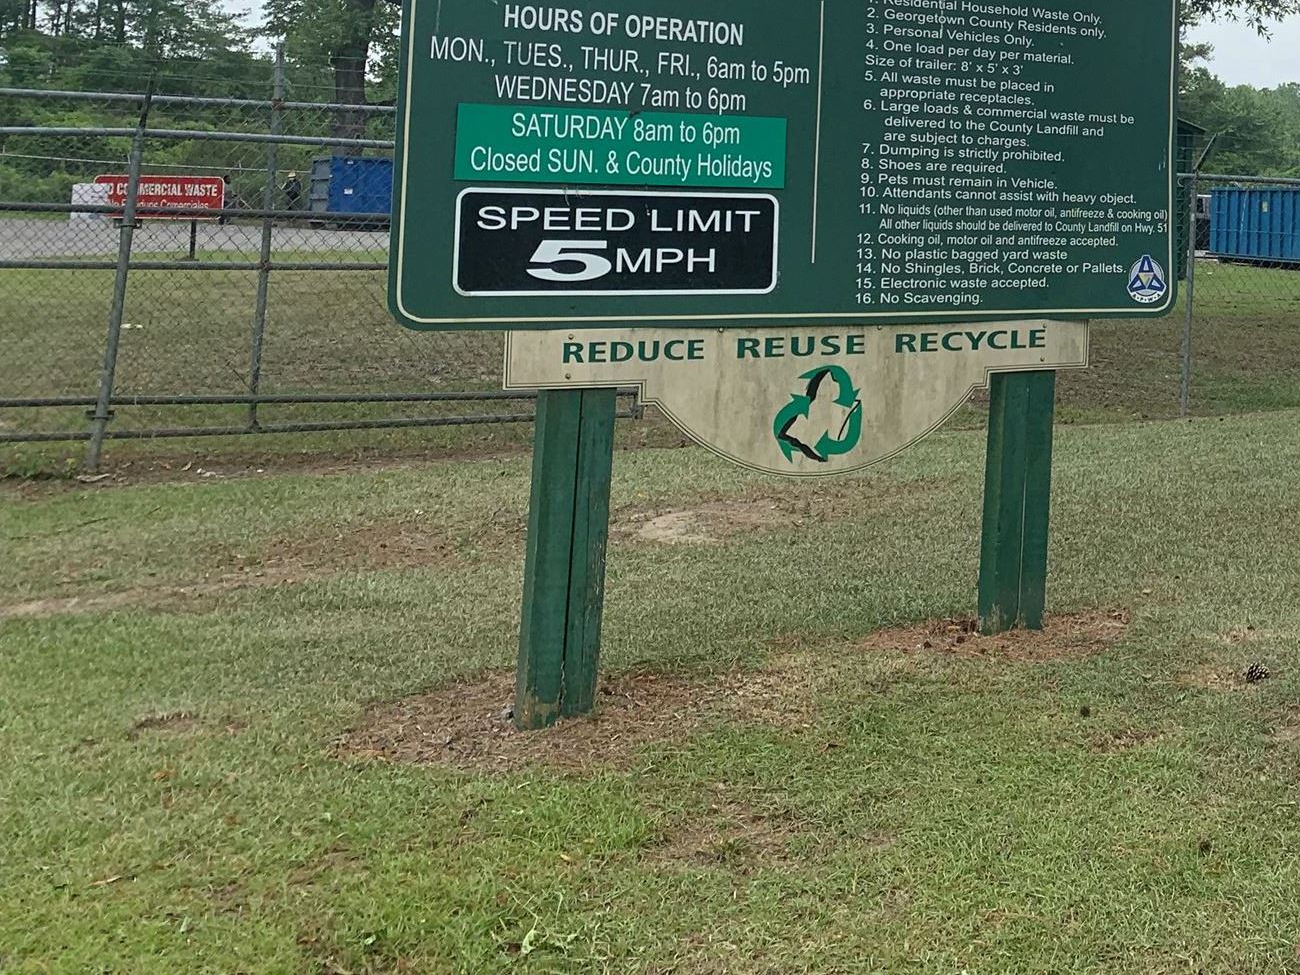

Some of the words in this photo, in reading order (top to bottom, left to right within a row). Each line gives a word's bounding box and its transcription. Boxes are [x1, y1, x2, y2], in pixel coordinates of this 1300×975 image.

[504, 4, 583, 33] HOURS
[590, 11, 619, 35] OF
[625, 14, 743, 46] OPERATION
[867, 7, 879, 18] 2.
[884, 8, 965, 25] Georgetown
[969, 16, 1014, 32] County
[1018, 20, 1077, 35] Residents
[1080, 27, 1107, 40] only.
[961, 1, 1028, 17] Household
[1032, 7, 1069, 21] Waste
[1073, 11, 1102, 26] Only.
[866, 23, 879, 34] 3.
[883, 24, 943, 40] Personal
[946, 29, 1000, 44] Vehicles
[1004, 34, 1034, 48] Only.
[430, 35, 495, 67] MON.,
[503, 40, 573, 72] TUES.,
[580, 46, 649, 77] THUR.,
[658, 52, 700, 81] FRI.,
[707, 56, 745, 80] 6am
[751, 60, 767, 81] to
[773, 61, 809, 88] 5pm
[865, 39, 879, 50] 4.
[883, 40, 912, 52] One
[916, 42, 944, 54] load
[948, 47, 970, 57] per
[973, 47, 996, 61] day
[1000, 51, 1020, 61] per
[1023, 52, 1074, 65] material.
[864, 70, 877, 81] 5.
[880, 71, 898, 82] All
[902, 75, 941, 85] waste
[945, 77, 977, 87] must
[981, 78, 996, 89] be
[1000, 79, 1040, 92] placed
[1044, 82, 1054, 93] in
[495, 74, 635, 105] WEDNESDAY
[640, 83, 679, 108] 7am
[685, 87, 702, 109] to
[708, 87, 746, 116] 6pm
[880, 88, 956, 101] appropriate
[960, 93, 1035, 105] receptacles.
[863, 99, 876, 110] 6.
[881, 100, 920, 115] Large
[924, 102, 959, 114] loads
[963, 104, 972, 115] &
[976, 108, 1047, 119] commercial
[1050, 112, 1085, 122] waste
[1088, 114, 1117, 123] must
[1120, 113, 1135, 124] be
[512, 112, 628, 140] SATURDAY
[633, 118, 673, 142] 8am
[679, 120, 696, 143] to
[703, 122, 740, 149] 6pm
[884, 116, 946, 129] delivered
[949, 119, 962, 130] to
[966, 120, 986, 131] the
[989, 121, 1033, 135] County
[1036, 123, 1078, 135] Landfill
[1082, 126, 1104, 137] and
[471, 146, 541, 172] Closed
[548, 148, 598, 173] SUN.
[606, 150, 619, 174] &
[626, 151, 692, 182] County
[697, 153, 772, 183] Holidays
[862, 143, 874, 155] 7.
[879, 144, 939, 159] Dumping
[944, 146, 954, 157] is
[958, 148, 999, 161] strictly
[1002, 150, 1065, 162] prohibited.
[861, 158, 873, 169] 8.
[878, 158, 921, 171] Shoes
[926, 162, 947, 171] are
[951, 162, 1007, 174] required.
[117, 183, 182, 196] COMERCIAL
[185, 183, 218, 197] WASTE
[860, 172, 873, 184] 9.
[878, 173, 908, 185] Pets
[913, 176, 945, 186] must
[949, 176, 992, 187] remain
[996, 177, 1007, 187] in
[1011, 177, 1057, 189] Vehicle.
[860, 186, 879, 197] 10.
[882, 187, 952, 199] Attendants
[955, 190, 996, 200] cannot
[999, 190, 1033, 201] assist
[1036, 191, 1059, 202] with
[1063, 191, 1097, 205] heavy
[1099, 193, 1137, 206] object.
[477, 206, 635, 231] SPEED
[651, 209, 761, 232] LIMIT
[859, 203, 876, 214] 11.
[880, 203, 895, 214] No
[898, 204, 931, 217] liquids
[934, 204, 964, 217] (other
[966, 205, 987, 216] than
[989, 206, 1013, 217] used
[1015, 207, 1042, 217] motor
[1044, 207, 1057, 219] oil,
[1060, 207, 1105, 218] antifreeze
[1107, 208, 1114, 219] &
[1116, 209, 1151, 222] cooking
[1154, 209, 1167, 221] oil)
[857, 233, 874, 244] 12.
[878, 233, 924, 247] Cooking
[928, 234, 943, 246] oil,
[947, 235, 978, 245] motor
[980, 234, 993, 245] oil
[995, 235, 1015, 245] and
[1017, 235, 1067, 246] antifreeze
[1069, 236, 1119, 248] accepted.
[526, 240, 612, 282] 5
[615, 248, 716, 273] MPH
[857, 248, 876, 259] 13.
[882, 248, 901, 259] No
[905, 248, 948, 262] plastic
[951, 249, 998, 262] bagged
[1002, 249, 1029, 262] yard
[1032, 250, 1068, 260] waste
[856, 263, 876, 274] 14.
[881, 263, 901, 274] No
[905, 262, 964, 276] Shingles,
[969, 262, 1004, 275] Brick,
[1008, 262, 1063, 273] Concrete
[1066, 265, 1079, 273] or
[1082, 262, 1126, 273] Pallets.
[856, 277, 876, 289] 15.
[881, 277, 946, 289] Electronic
[950, 278, 987, 288] waste
[991, 277, 1049, 290] accepted.
[562, 339, 704, 363] REDUCE
[737, 335, 865, 359] REUSE
[895, 329, 1046, 353] RECYCLE
